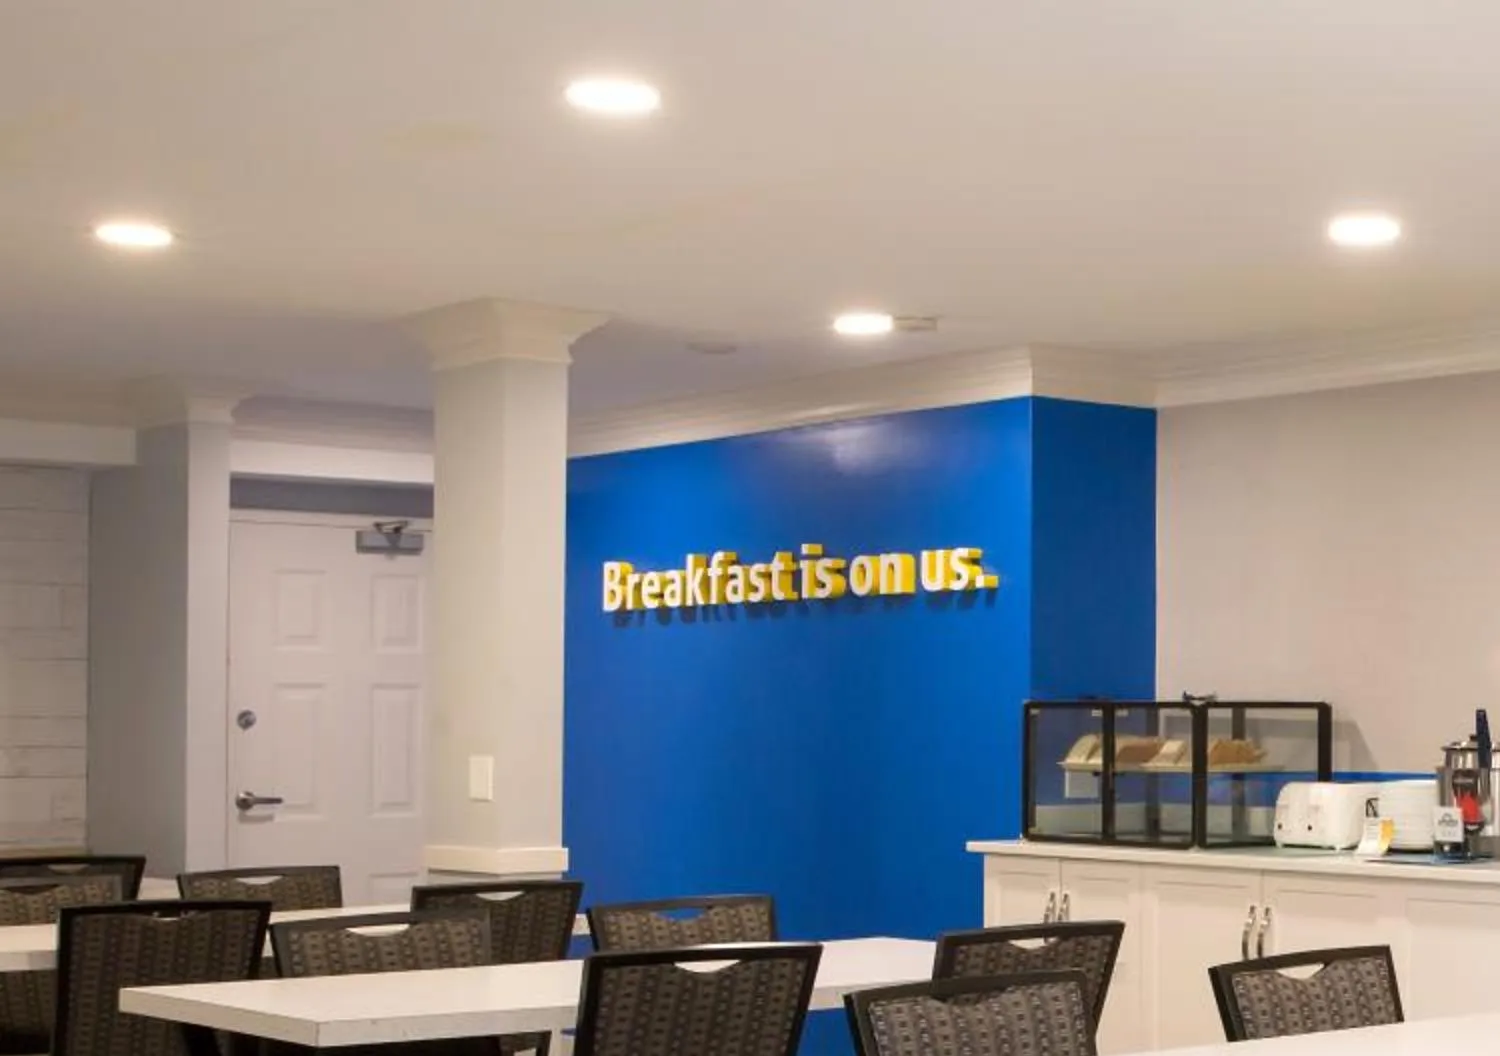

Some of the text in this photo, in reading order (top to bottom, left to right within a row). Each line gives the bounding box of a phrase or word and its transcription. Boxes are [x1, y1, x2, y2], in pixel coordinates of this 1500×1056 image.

[603, 543, 998, 612] Breakfast is on us.
